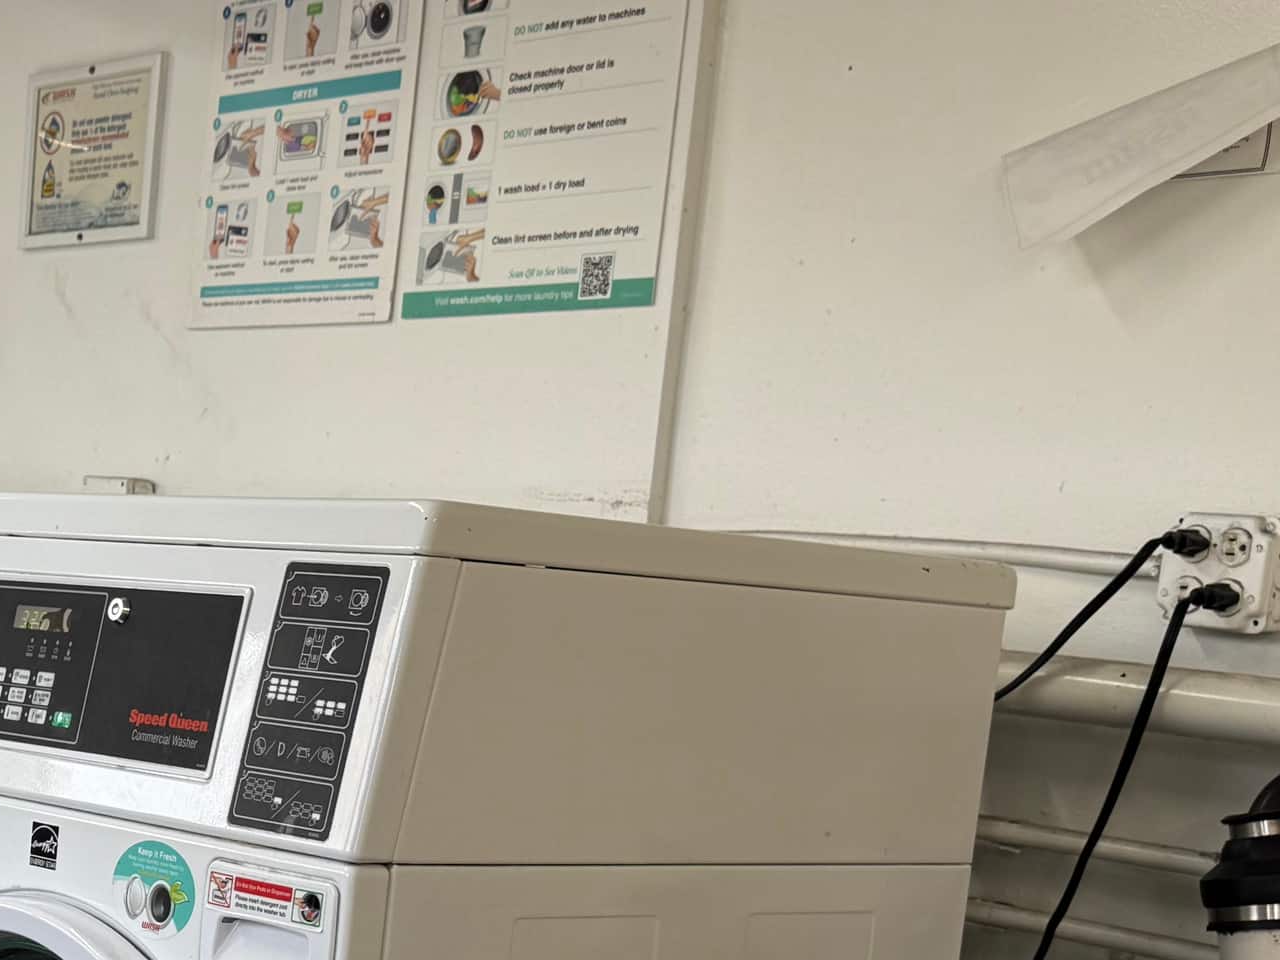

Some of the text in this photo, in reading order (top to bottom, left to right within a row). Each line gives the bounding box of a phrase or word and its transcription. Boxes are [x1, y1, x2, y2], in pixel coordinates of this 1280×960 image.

[514, 7, 646, 36] DO NOT add any water to machines
[509, 58, 614, 82] Check machine door or lid is
[292, 88, 318, 100] DRYER
[508, 79, 564, 95] closed properly
[504, 116, 627, 140] DO NOT use foreign or bent coins
[504, 184, 522, 194] wash
[524, 182, 540, 193] load
[554, 180, 566, 192] dry
[568, 177, 585, 188] load
[492, 224, 639, 246] Clean lint screen before and after drying
[128, 708, 209, 732] Speed Queen
[131, 728, 198, 749] Commercial Washer
[138, 847, 154, 858] Keep
[160, 850, 176, 862] Fresh
